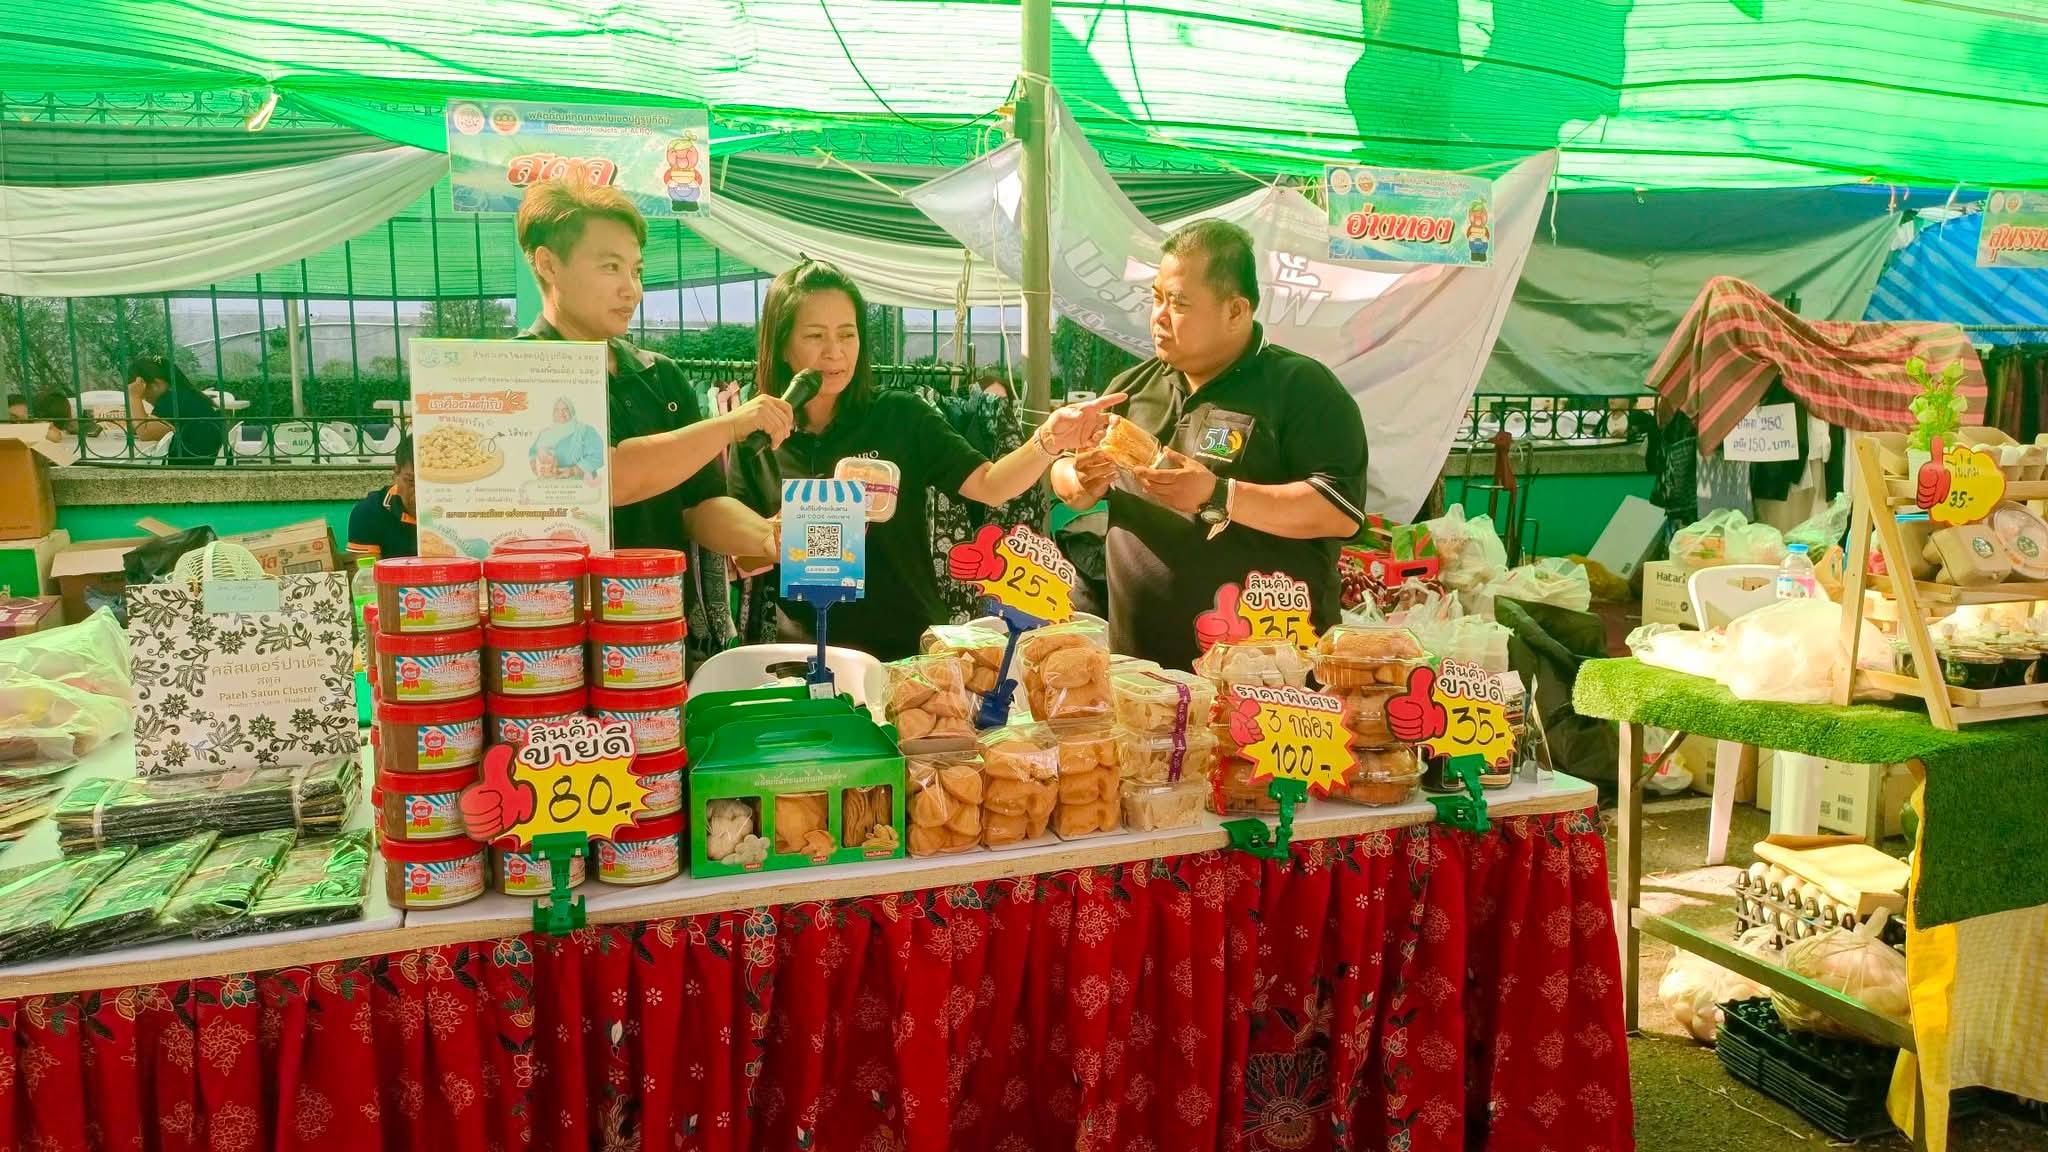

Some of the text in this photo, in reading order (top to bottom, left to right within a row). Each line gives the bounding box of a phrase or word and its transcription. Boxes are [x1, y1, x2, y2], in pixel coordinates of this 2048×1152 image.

[1346, 203, 1455, 245] อ่างทอง
[1008, 538, 1073, 585] ขายดี
[1250, 574, 1292, 592] สินค้า
[1246, 586, 1308, 608] ขายดี
[256, 675, 281, 687] สตูล
[1444, 660, 1487, 682] สินค้า
[219, 685, 319, 701] Pateh Satun Cluster
[1236, 685, 1339, 710] ราคาพิเศษ
[1440, 677, 1504, 703] ขายดี
[531, 719, 599, 744] สินค้า
[1266, 708, 1333, 740] 3 กล่อง
[523, 725, 631, 766] ขายดี
